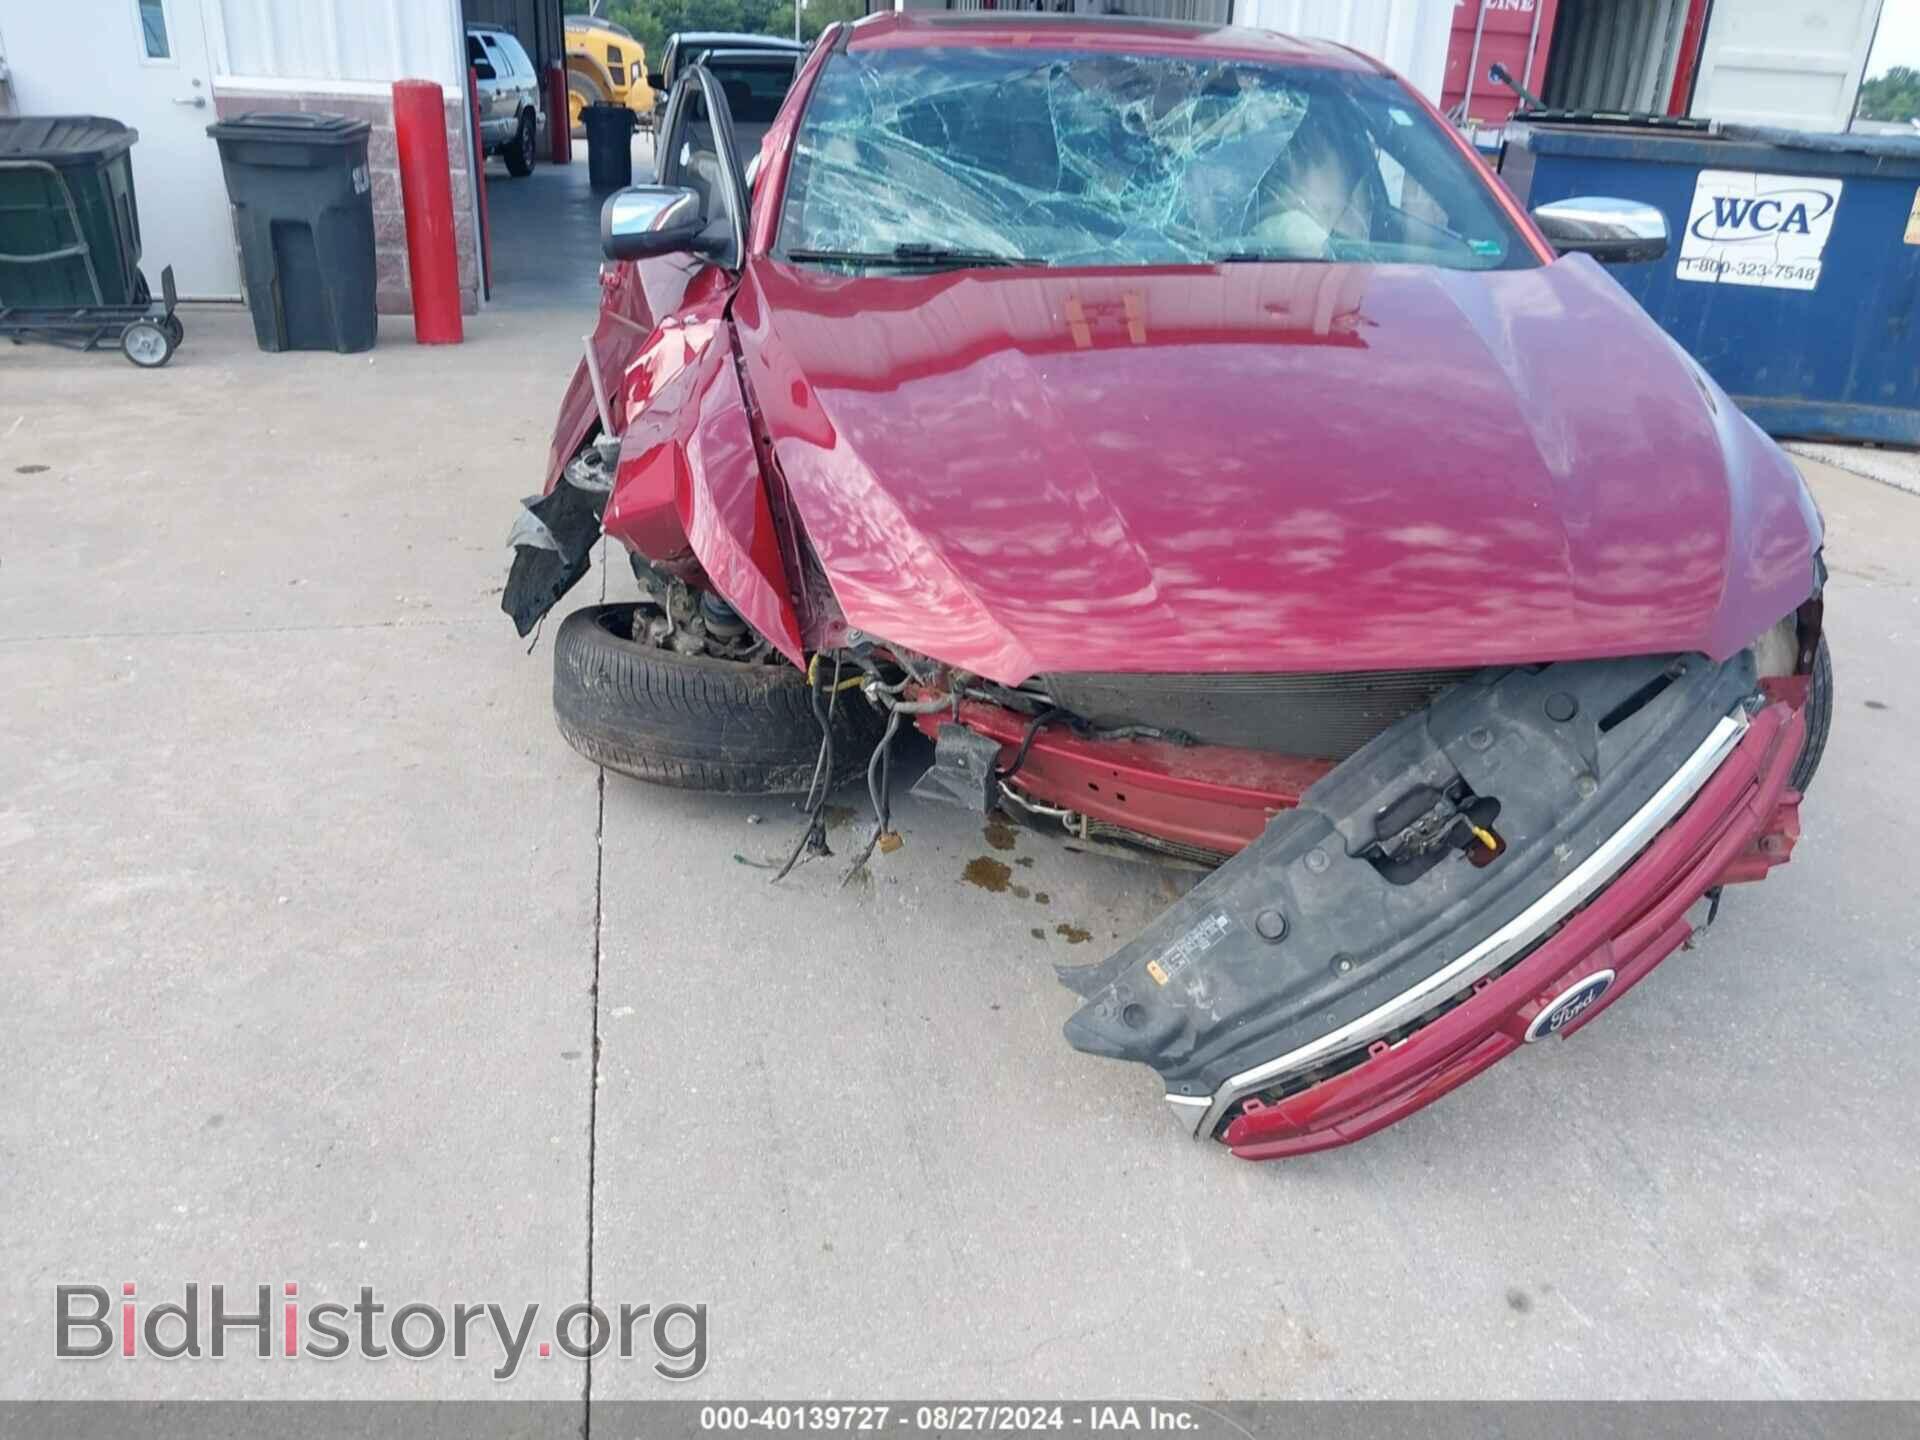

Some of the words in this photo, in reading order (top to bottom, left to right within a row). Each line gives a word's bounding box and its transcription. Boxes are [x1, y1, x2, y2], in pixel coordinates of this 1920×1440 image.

[1712, 196, 1811, 235] WCA
[1685, 258, 1816, 281] 1-800-323-7548
[1549, 988, 1596, 1031] Ford
